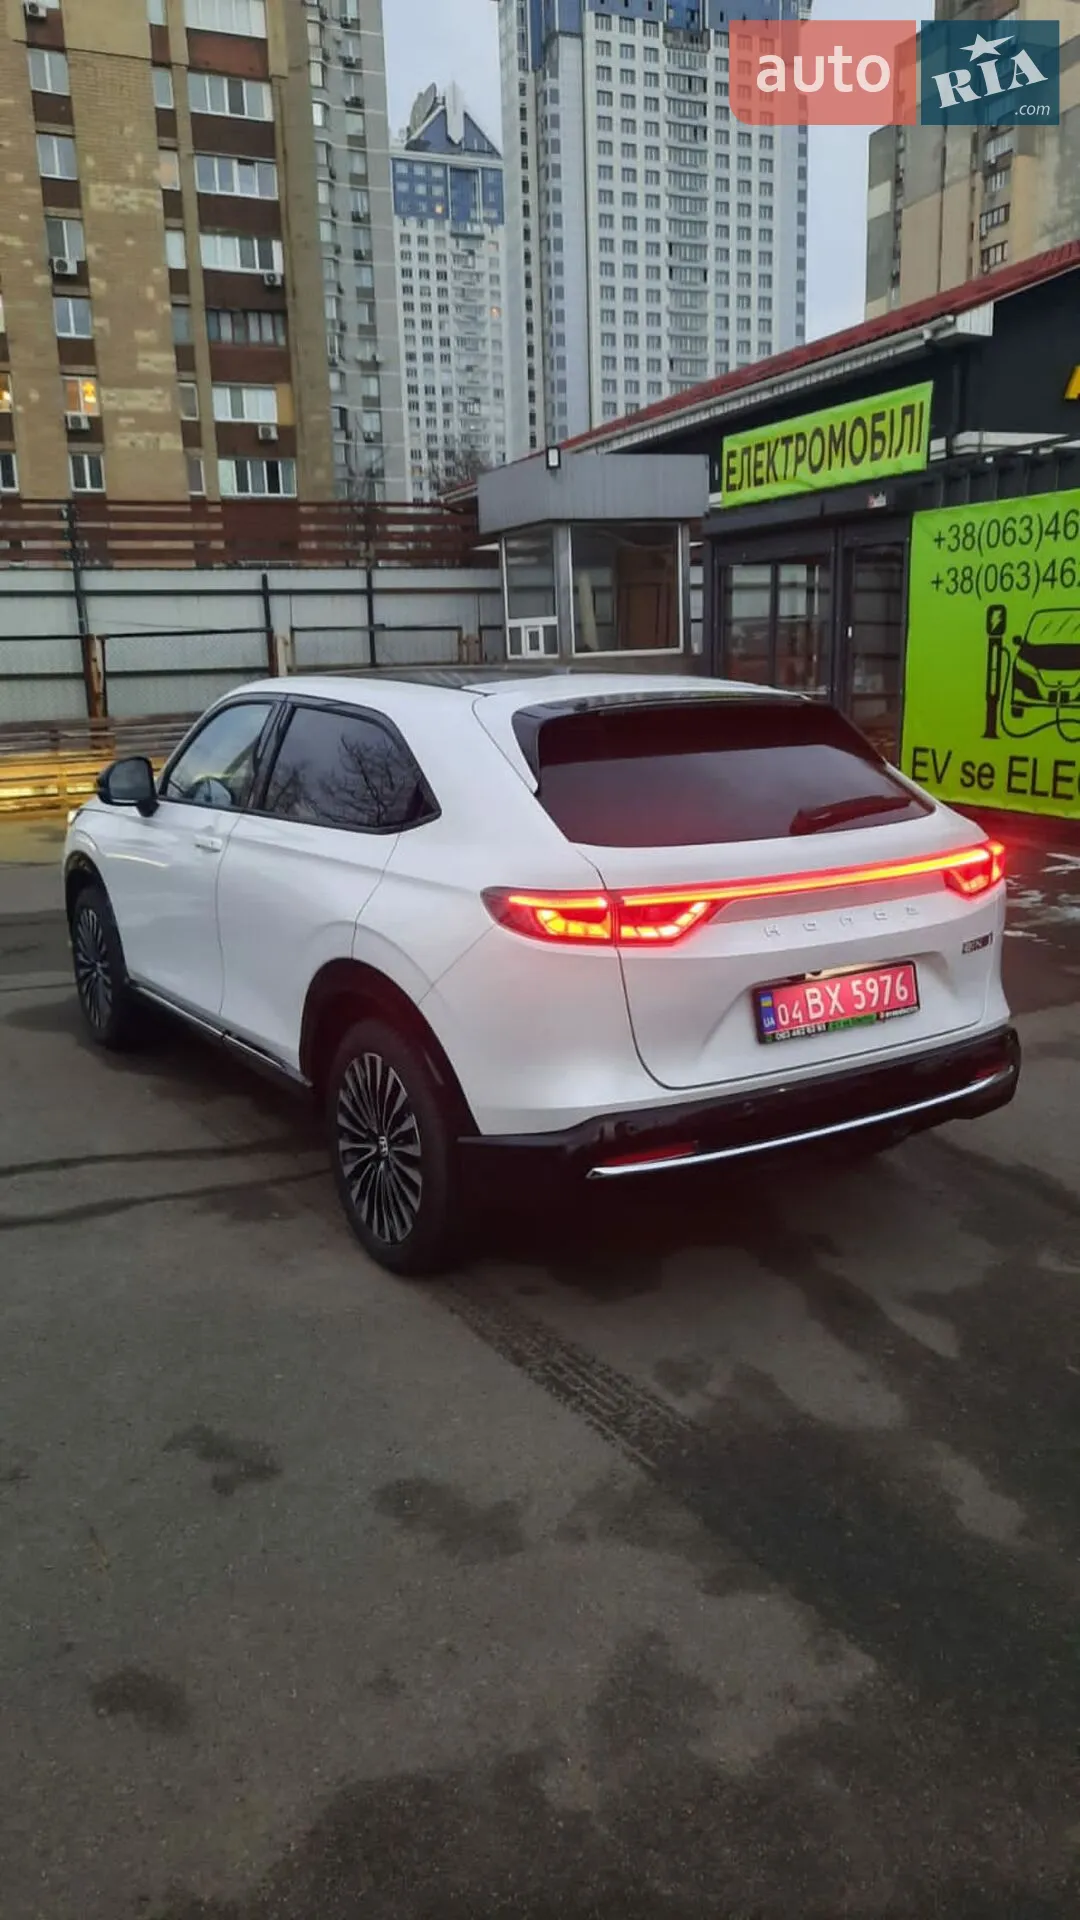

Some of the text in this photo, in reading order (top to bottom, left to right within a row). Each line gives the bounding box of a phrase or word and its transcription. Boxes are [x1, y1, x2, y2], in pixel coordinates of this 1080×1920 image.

[726, 401, 924, 492] ЕЛЕКТРОМОБІЛІ
[931, 556, 1080, 600] +38(063)46
[911, 746, 1080, 800] EV se ELE
[763, 1016, 776, 1028] UA
[777, 1000, 803, 1026] 04
[804, 983, 845, 1020] BX
[851, 972, 909, 1010] 5976
